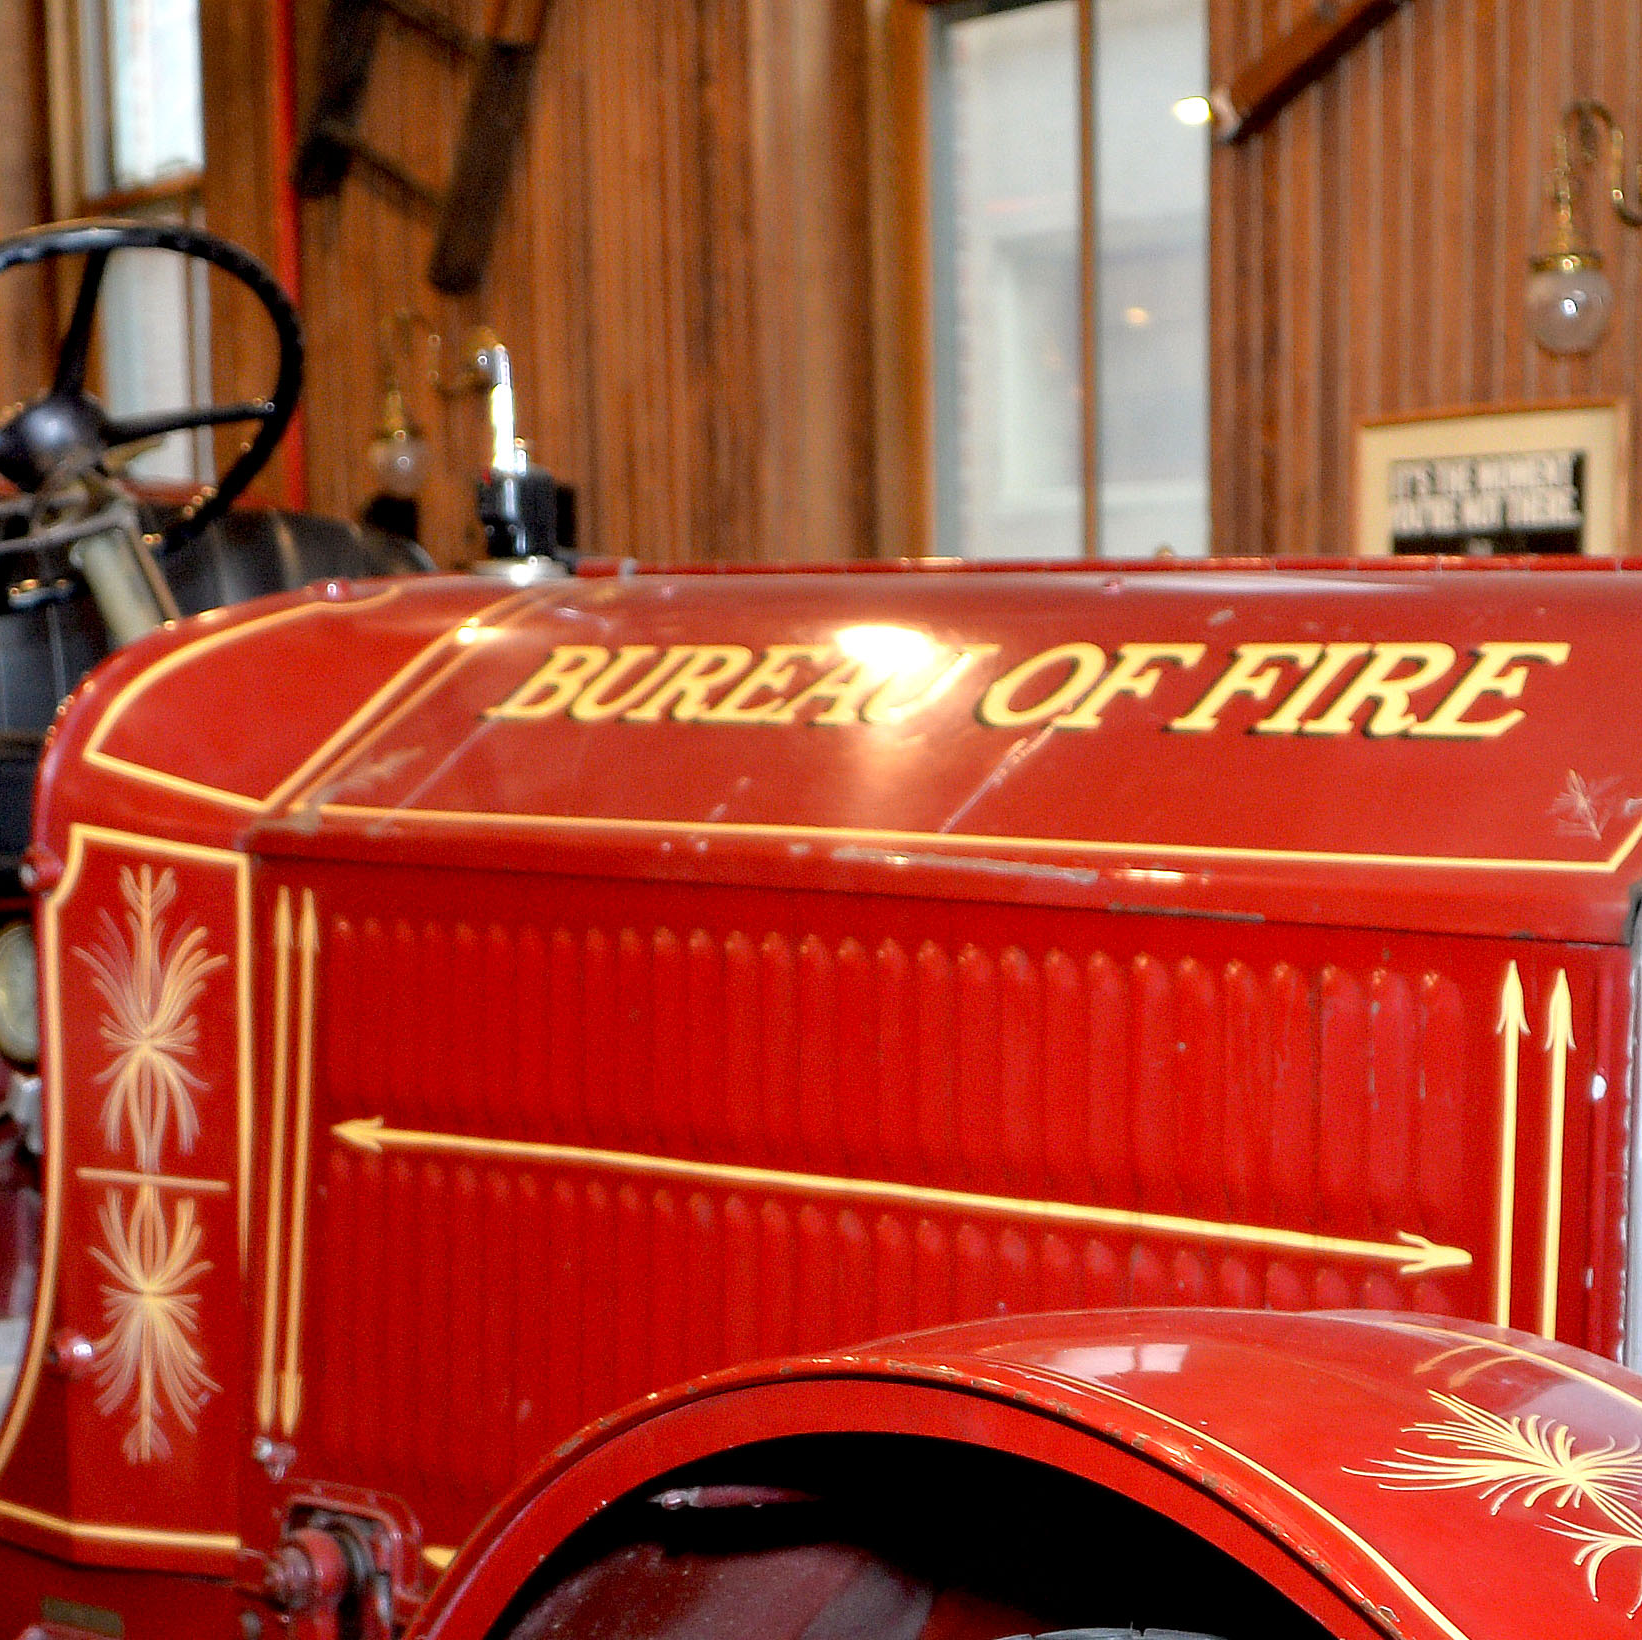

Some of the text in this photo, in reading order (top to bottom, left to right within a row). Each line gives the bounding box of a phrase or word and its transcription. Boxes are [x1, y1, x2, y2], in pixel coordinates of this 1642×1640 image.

[478, 641, 1572, 738] BUREAU OF FIRE
